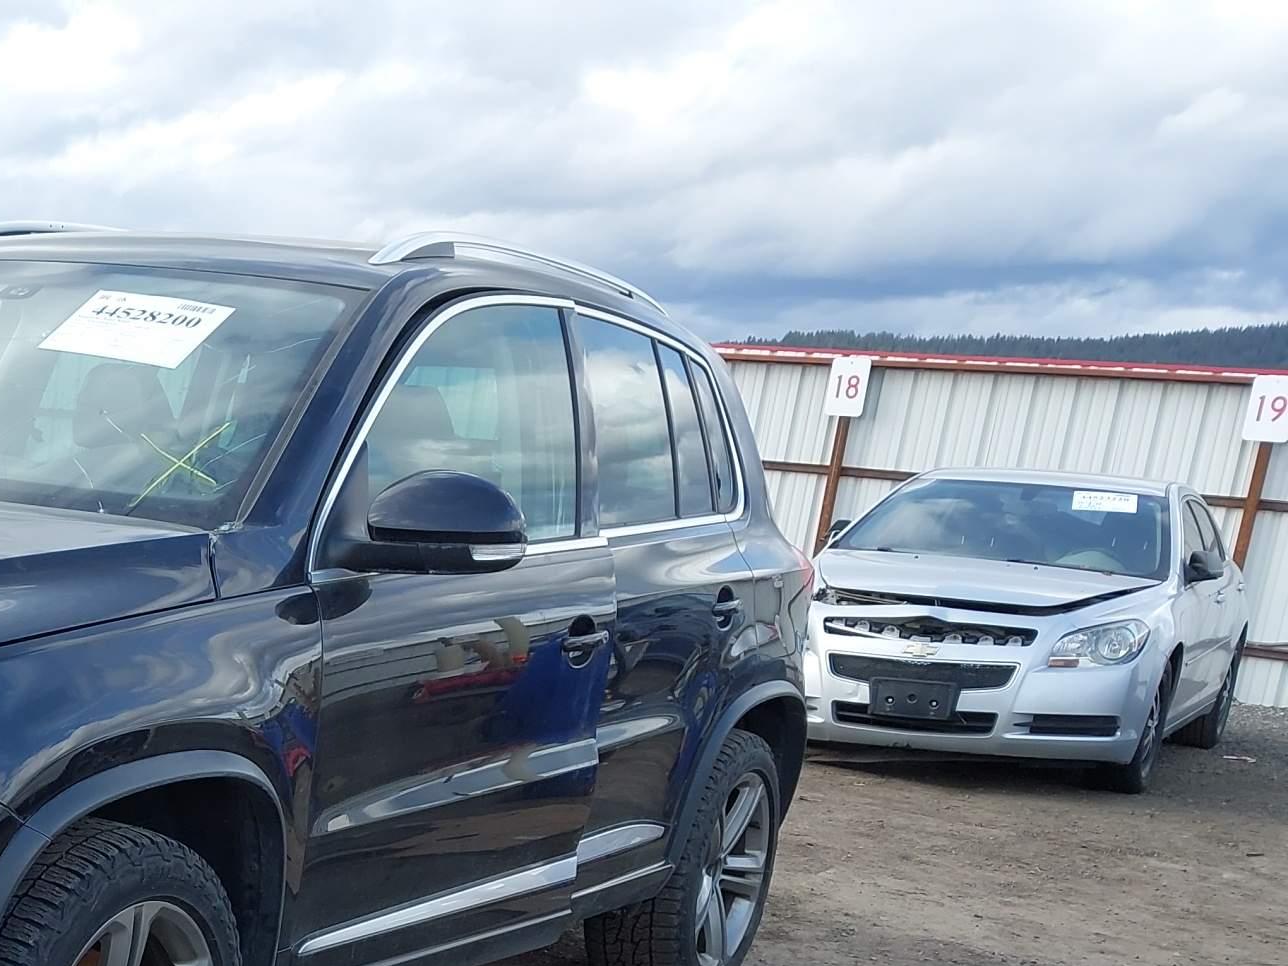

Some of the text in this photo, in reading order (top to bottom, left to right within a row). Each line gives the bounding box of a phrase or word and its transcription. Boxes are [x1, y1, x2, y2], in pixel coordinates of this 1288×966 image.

[92, 304, 202, 329] 44528200
[835, 374, 861, 400] 18
[1255, 394, 1288, 423] 19
